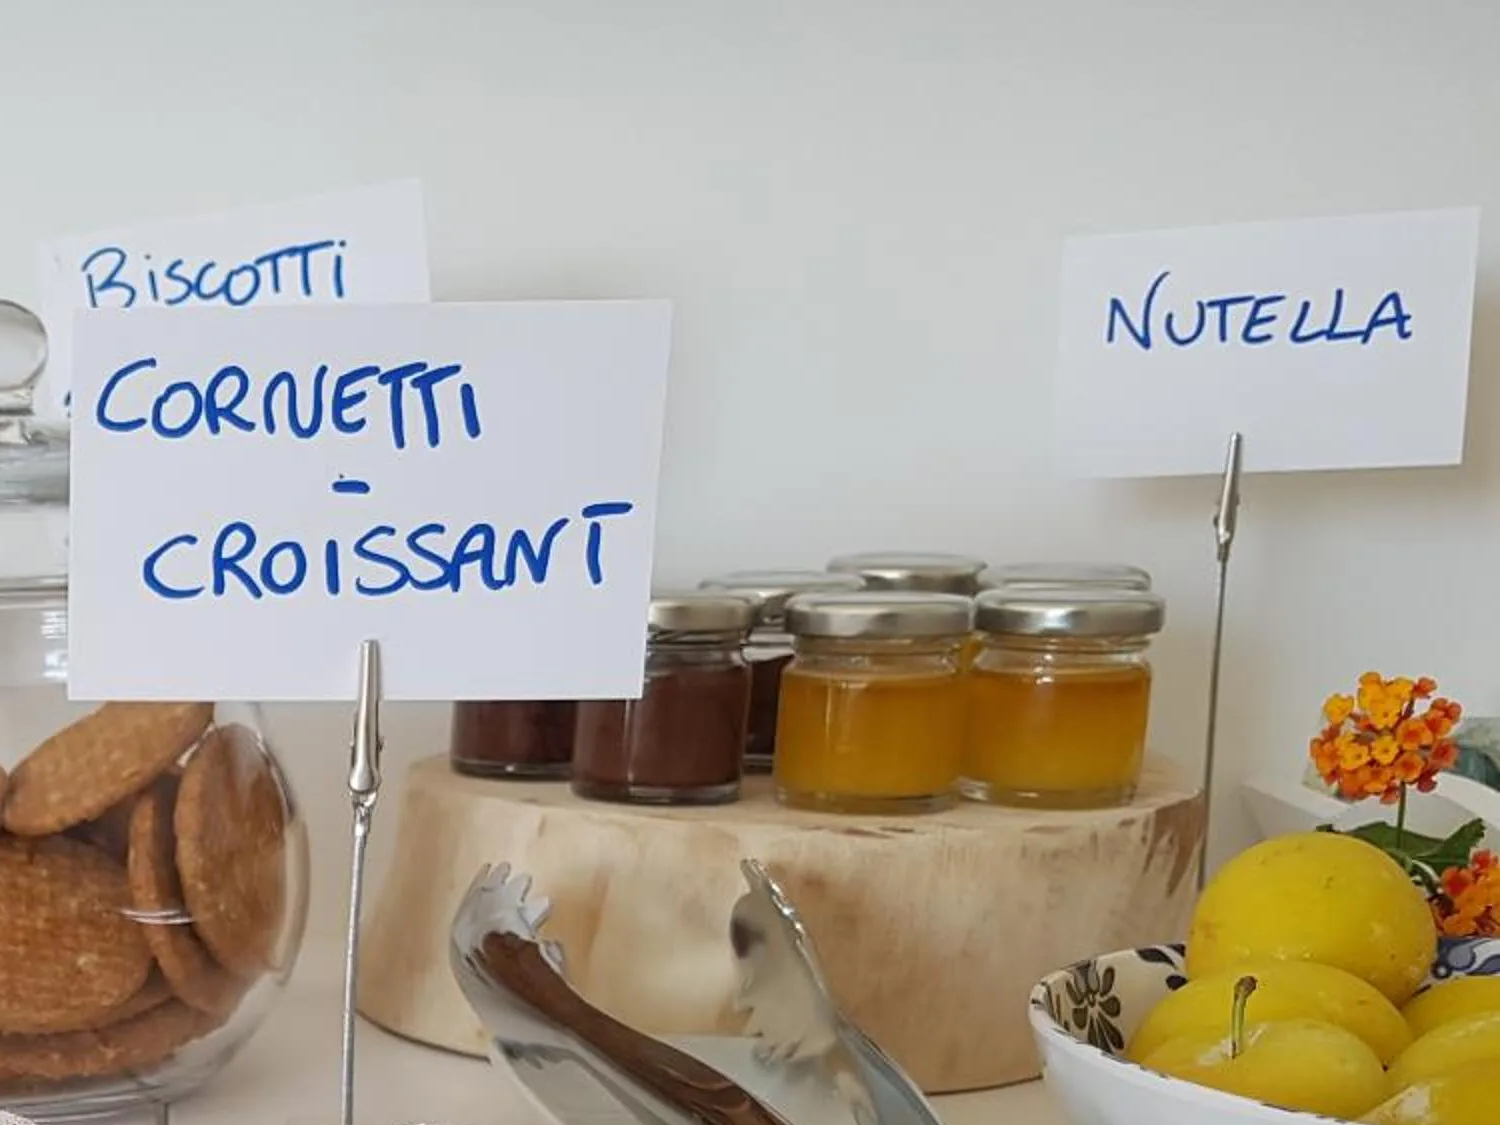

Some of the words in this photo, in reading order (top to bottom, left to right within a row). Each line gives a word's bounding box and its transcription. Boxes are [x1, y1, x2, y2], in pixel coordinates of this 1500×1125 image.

[1106, 270, 1413, 350] NUTELLA
[95, 356, 482, 449] CORNETTI
[141, 500, 634, 601] CROISSANT
